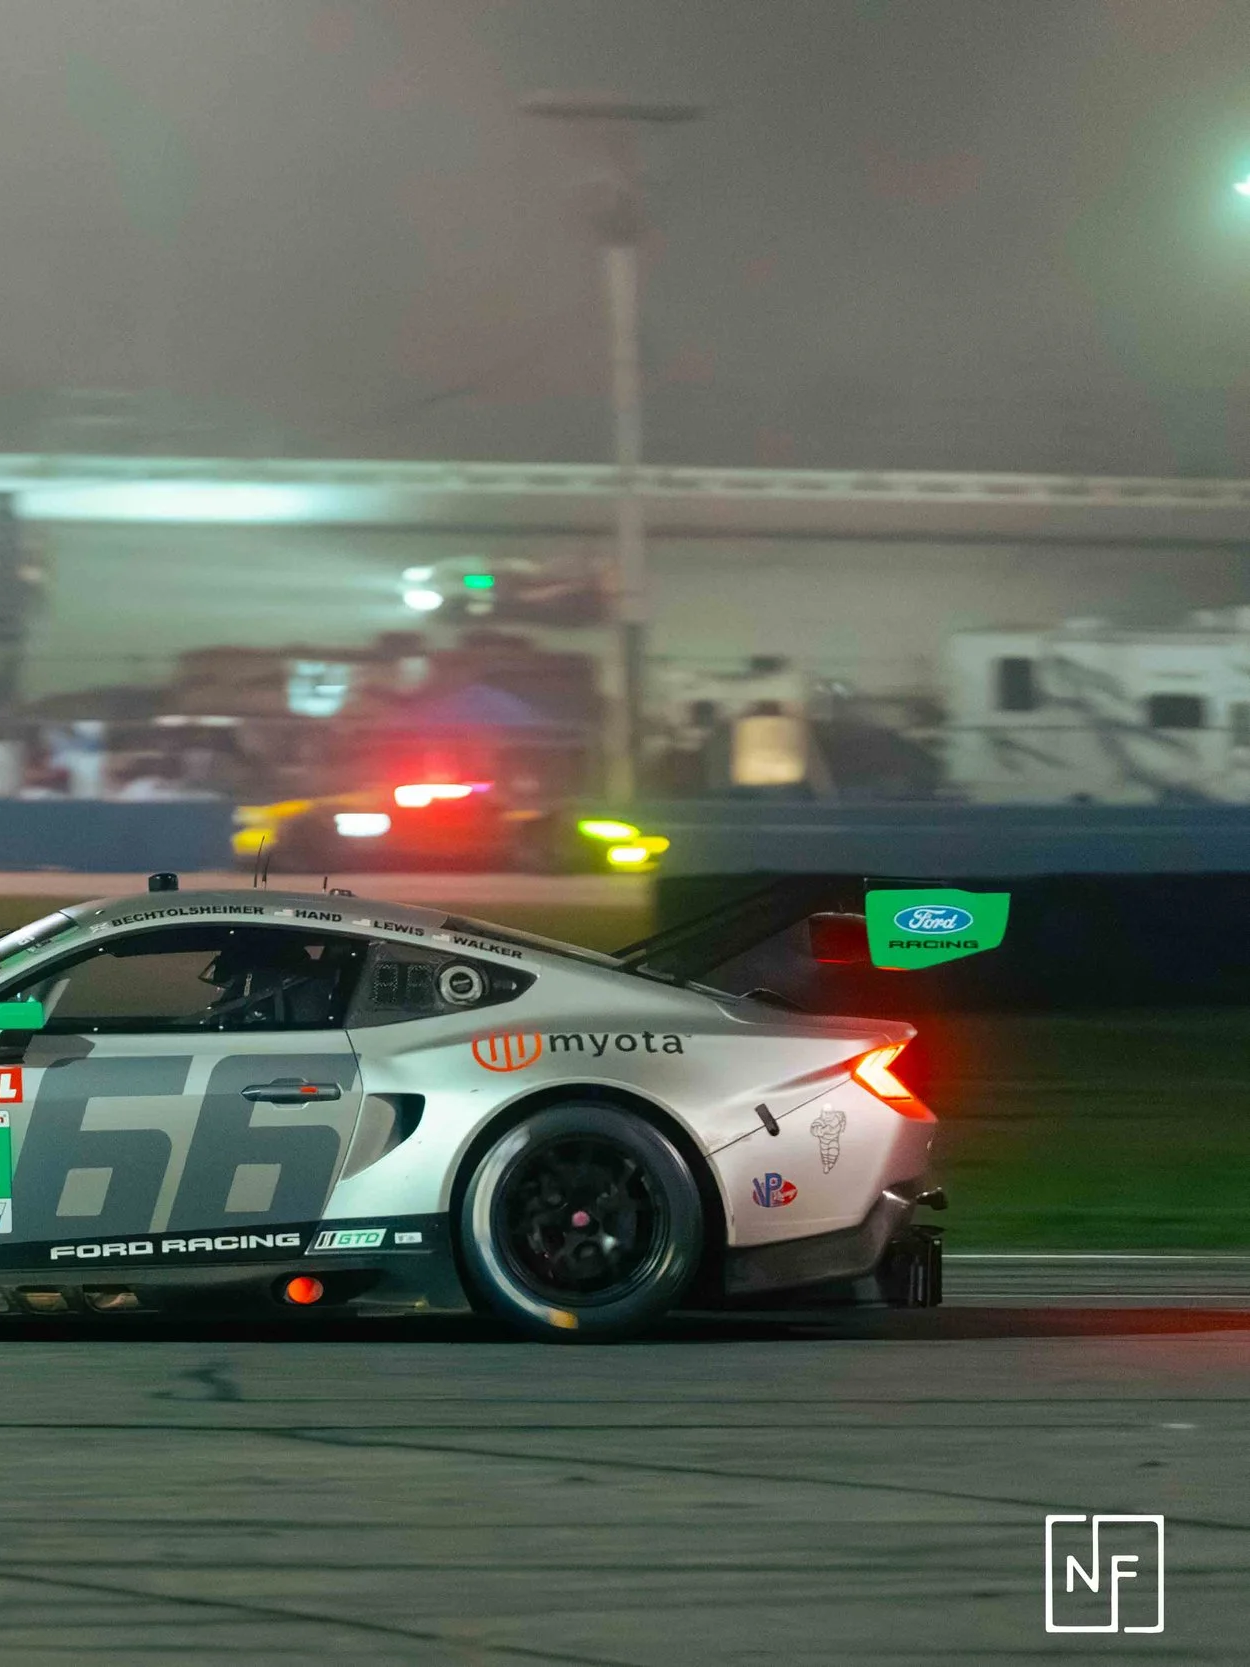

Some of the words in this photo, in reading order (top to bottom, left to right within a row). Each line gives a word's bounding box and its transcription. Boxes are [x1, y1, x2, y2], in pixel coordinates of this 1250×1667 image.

[111, 905, 265, 928] BECHTOLSHEIMER
[295, 909, 343, 923] HAND
[373, 919, 425, 937] LEWIS
[453, 936, 523, 960] WALKER
[908, 909, 959, 930] Ford
[888, 940, 980, 949] RACING
[549, 1030, 684, 1057] myota
[0, 1053, 362, 1246] 66
[50, 1241, 154, 1260] FORD
[162, 1232, 300, 1253] RACING
[337, 1232, 380, 1245] GTD
